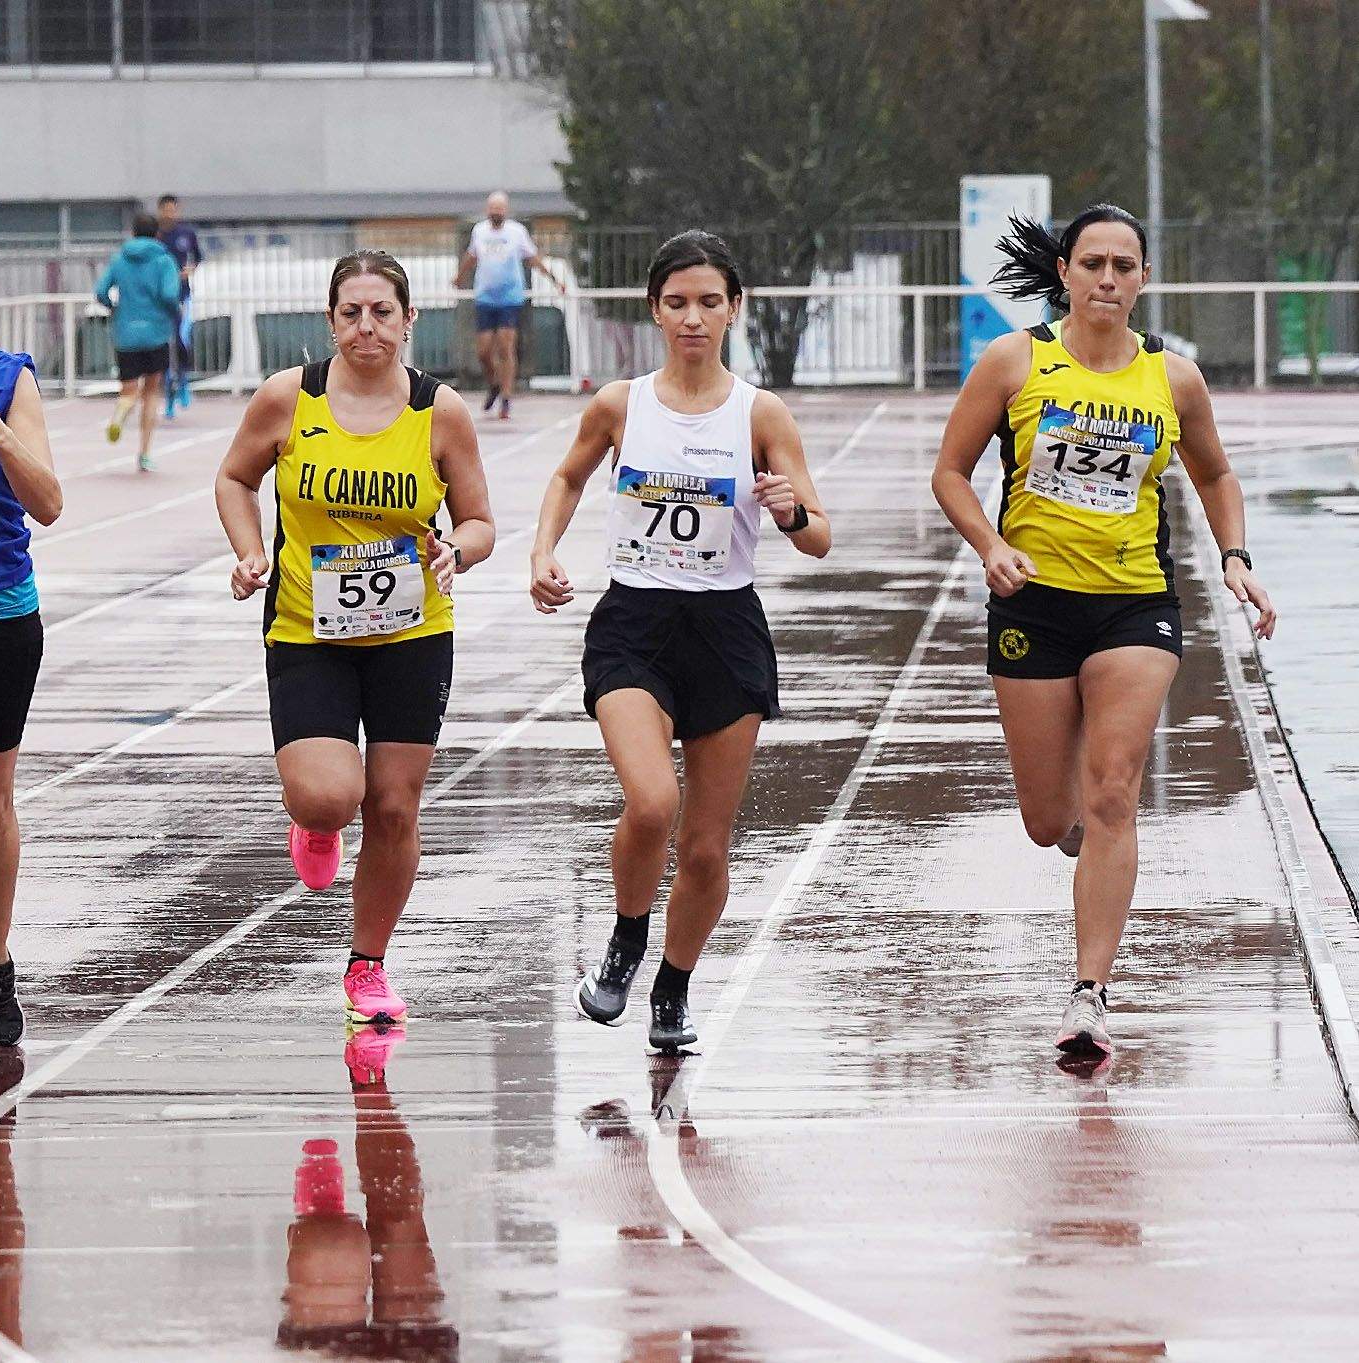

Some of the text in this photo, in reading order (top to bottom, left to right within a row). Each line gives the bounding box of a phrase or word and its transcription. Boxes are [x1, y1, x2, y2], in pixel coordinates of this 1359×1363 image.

[1072, 414, 1129, 439] XI MILLA
[1106, 439, 1145, 453] DIABETES
[1046, 442, 1132, 482] 134
[298, 462, 418, 510] EL CANARIO
[645, 472, 706, 492] XI MILLA
[327, 509, 384, 522] RIBEIRA
[641, 501, 701, 542] 70
[340, 540, 395, 559] XI MILLA
[355, 560, 375, 571] POLA
[376, 554, 411, 568] DIABETES
[337, 570, 397, 609] 59
